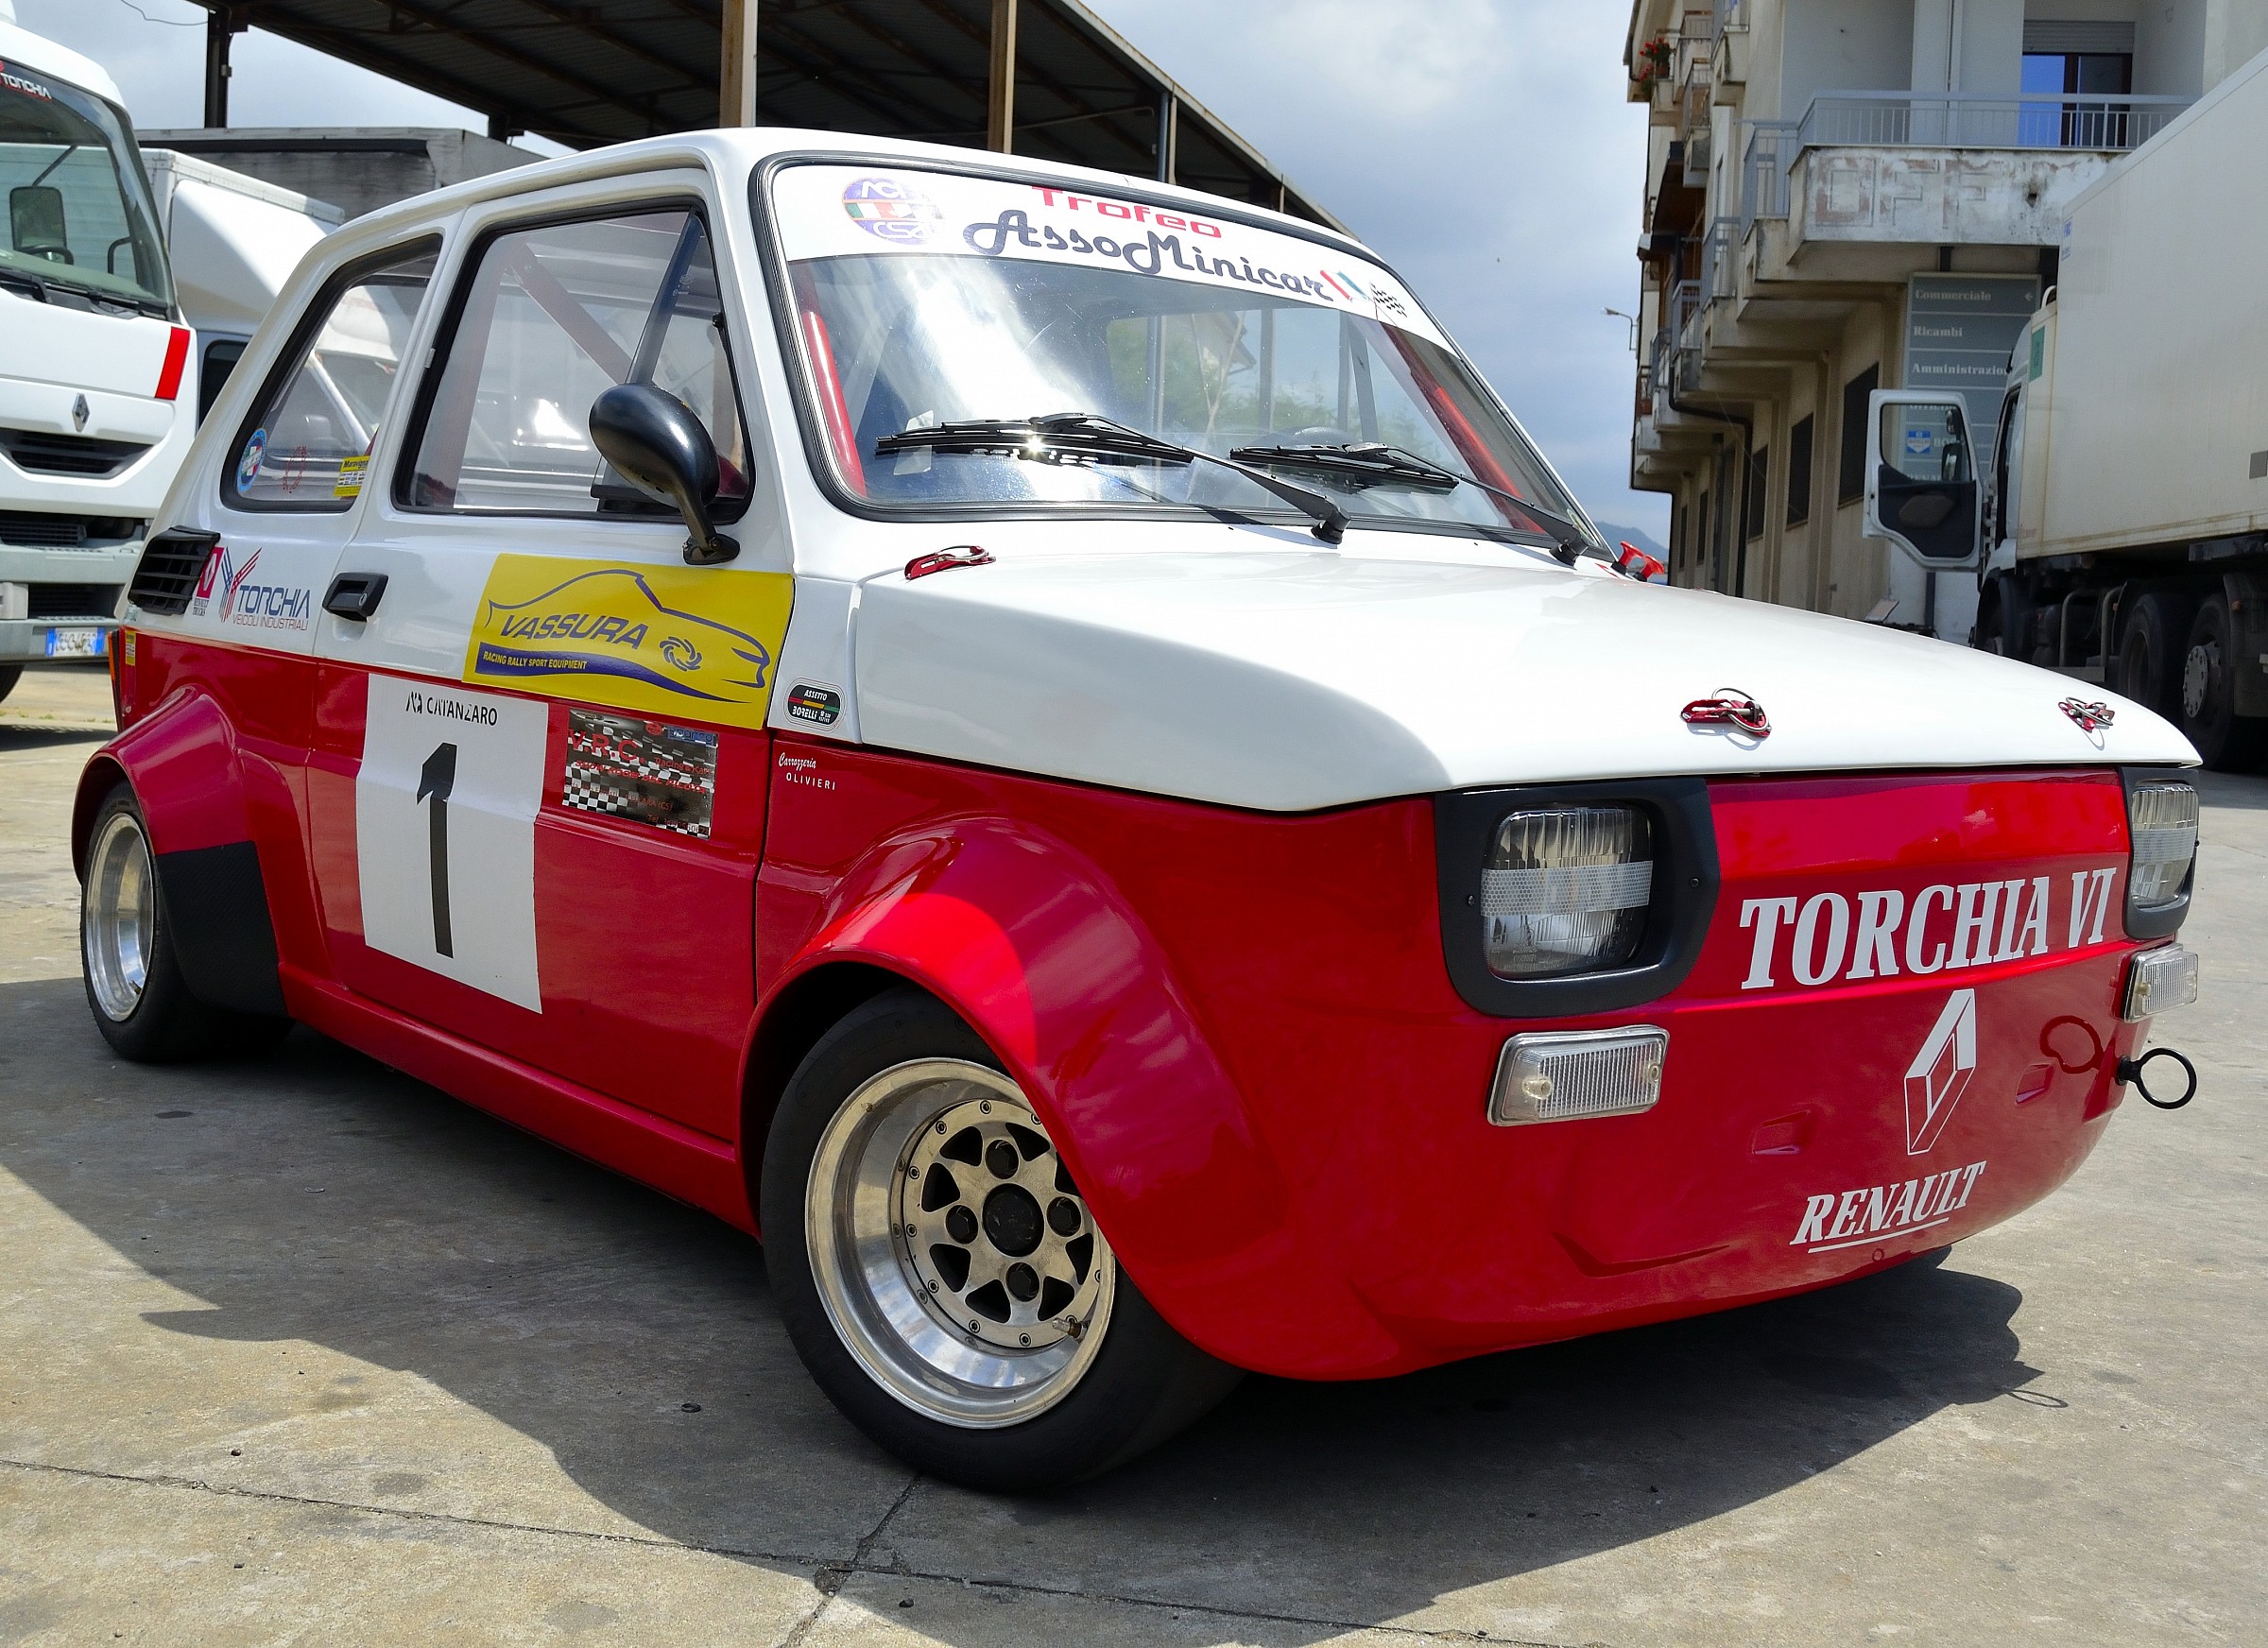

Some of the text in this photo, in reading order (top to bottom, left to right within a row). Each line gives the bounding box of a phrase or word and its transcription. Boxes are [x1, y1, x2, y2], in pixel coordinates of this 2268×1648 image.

[1032, 185, 1222, 238] Trofeo
[963, 209, 1333, 302] AssoMinicar
[1916, 288, 1991, 301] Commerciale
[1914, 325, 1963, 337] Ricambi
[238, 584, 311, 619] TORCHIA
[501, 613, 649, 650] VASSURA
[483, 651, 587, 670] RACING RALLY SPORT EQUIPMENT
[804, 690, 828, 701] ASSETTO
[778, 752, 817, 771] Carrozzeria
[785, 772, 835, 791] OLIVIERI
[417, 742, 458, 959] 1
[1739, 867, 2118, 989] TORCHIA VI
[1790, 1160, 1986, 1245] RENAULT
